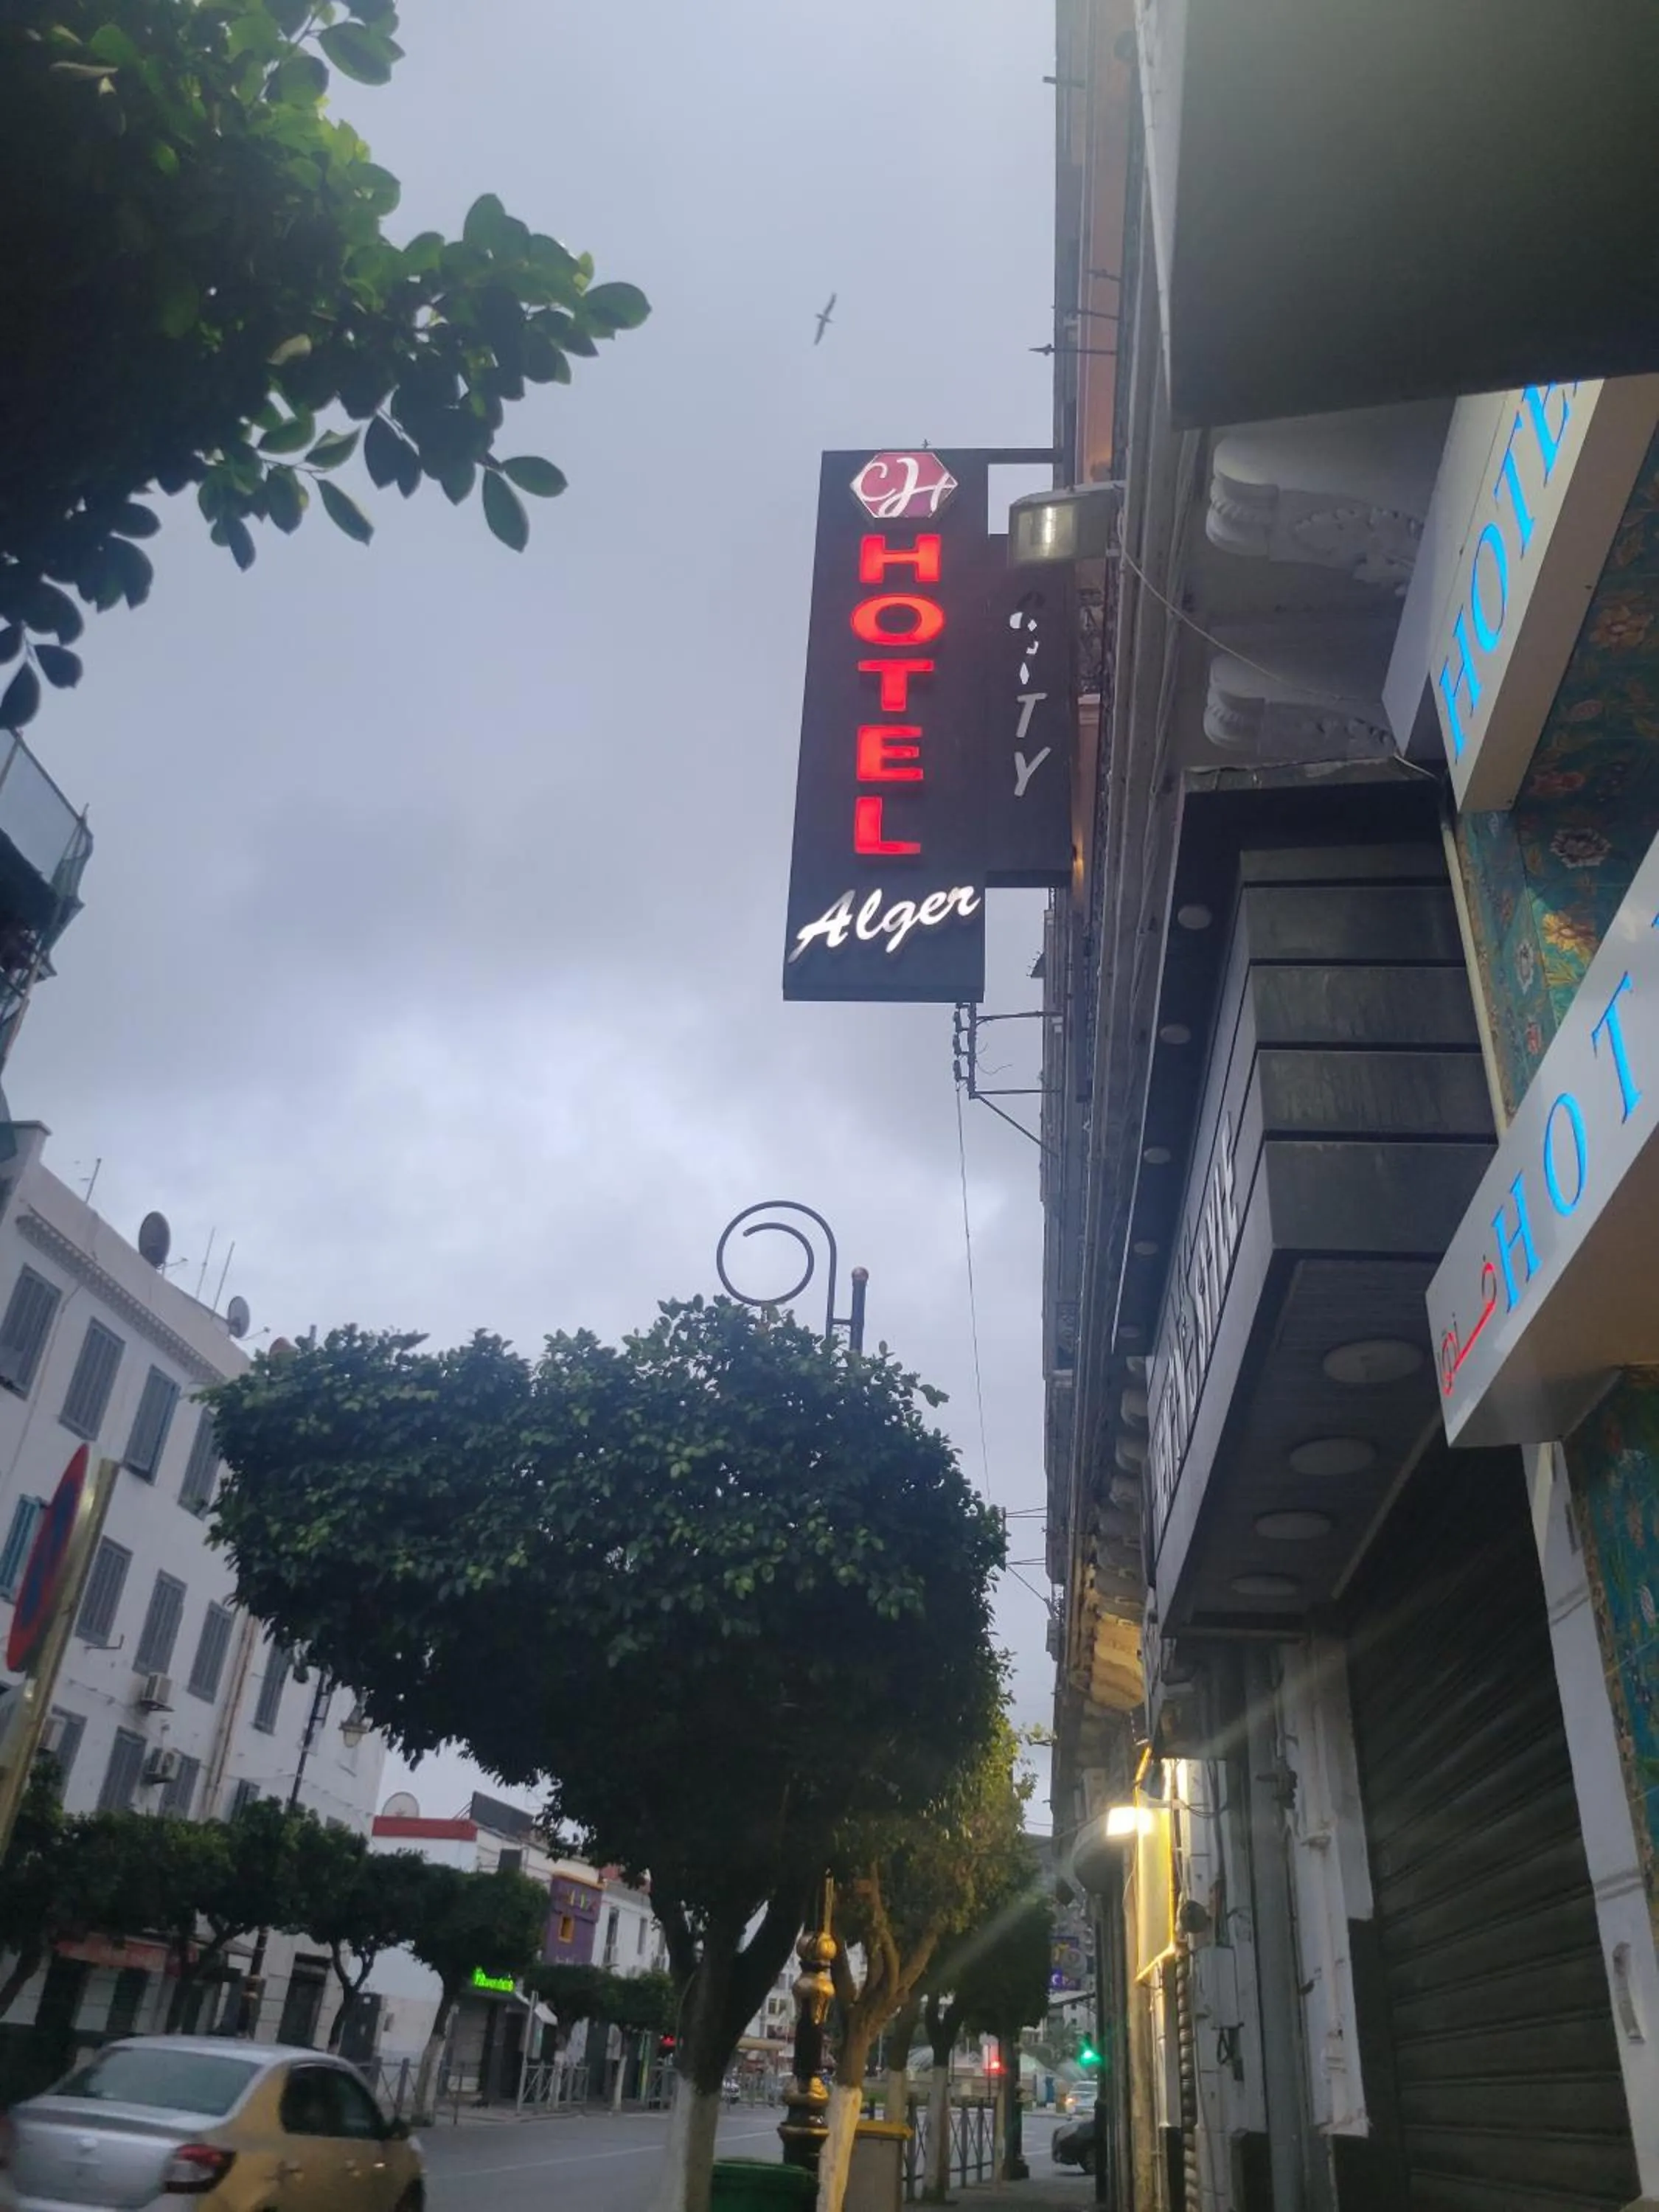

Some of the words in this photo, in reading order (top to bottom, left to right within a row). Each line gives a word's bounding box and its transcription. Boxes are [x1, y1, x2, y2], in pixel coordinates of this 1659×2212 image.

[850, 533, 946, 855] HOTEL
[1439, 380, 1579, 765] HOTE
[787, 885, 982, 964] Alger
[1491, 911, 1659, 1315] HOT
